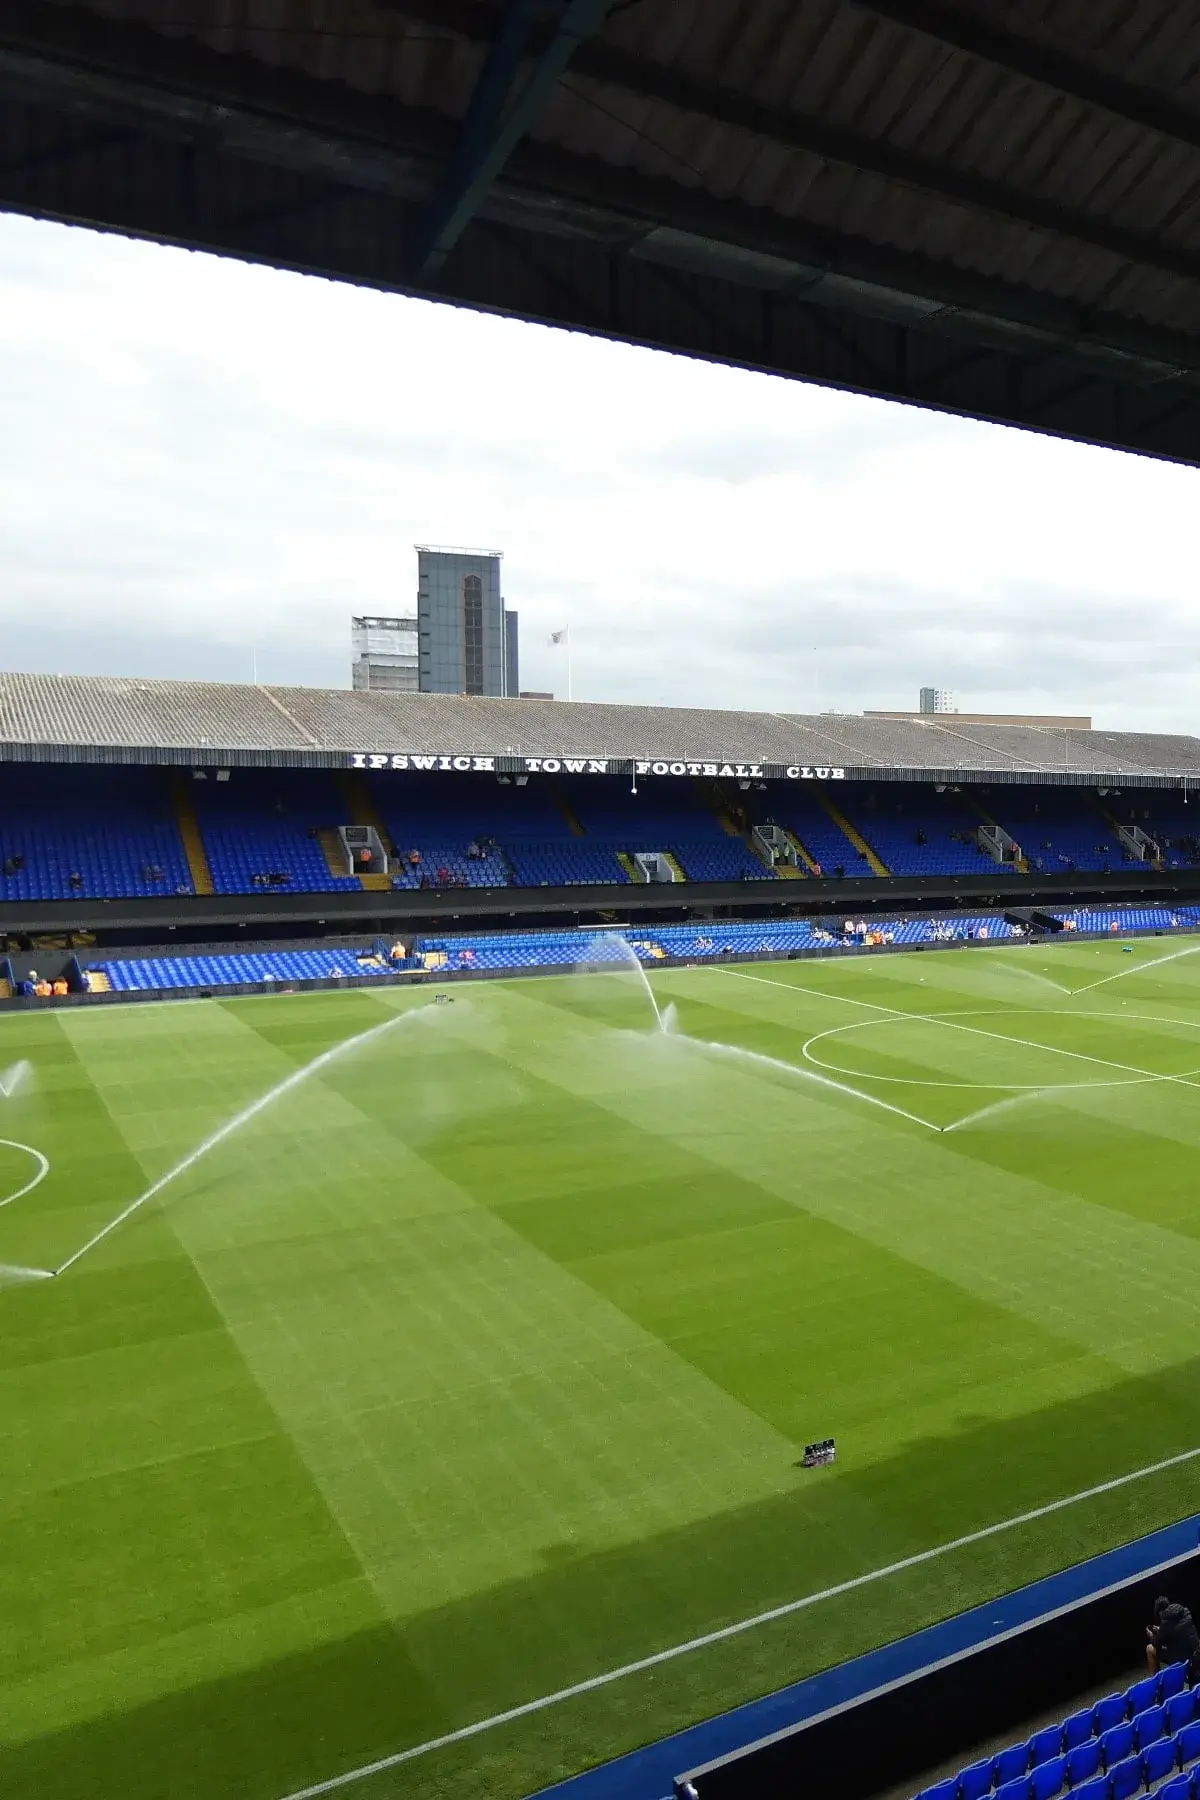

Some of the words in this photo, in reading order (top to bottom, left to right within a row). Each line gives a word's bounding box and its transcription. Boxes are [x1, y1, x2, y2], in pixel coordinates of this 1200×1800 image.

[352, 754, 495, 771] IPSWICH
[525, 758, 608, 773] TOWN
[635, 762, 763, 777] FOOTBALL
[786, 767, 845, 779] CLUB
